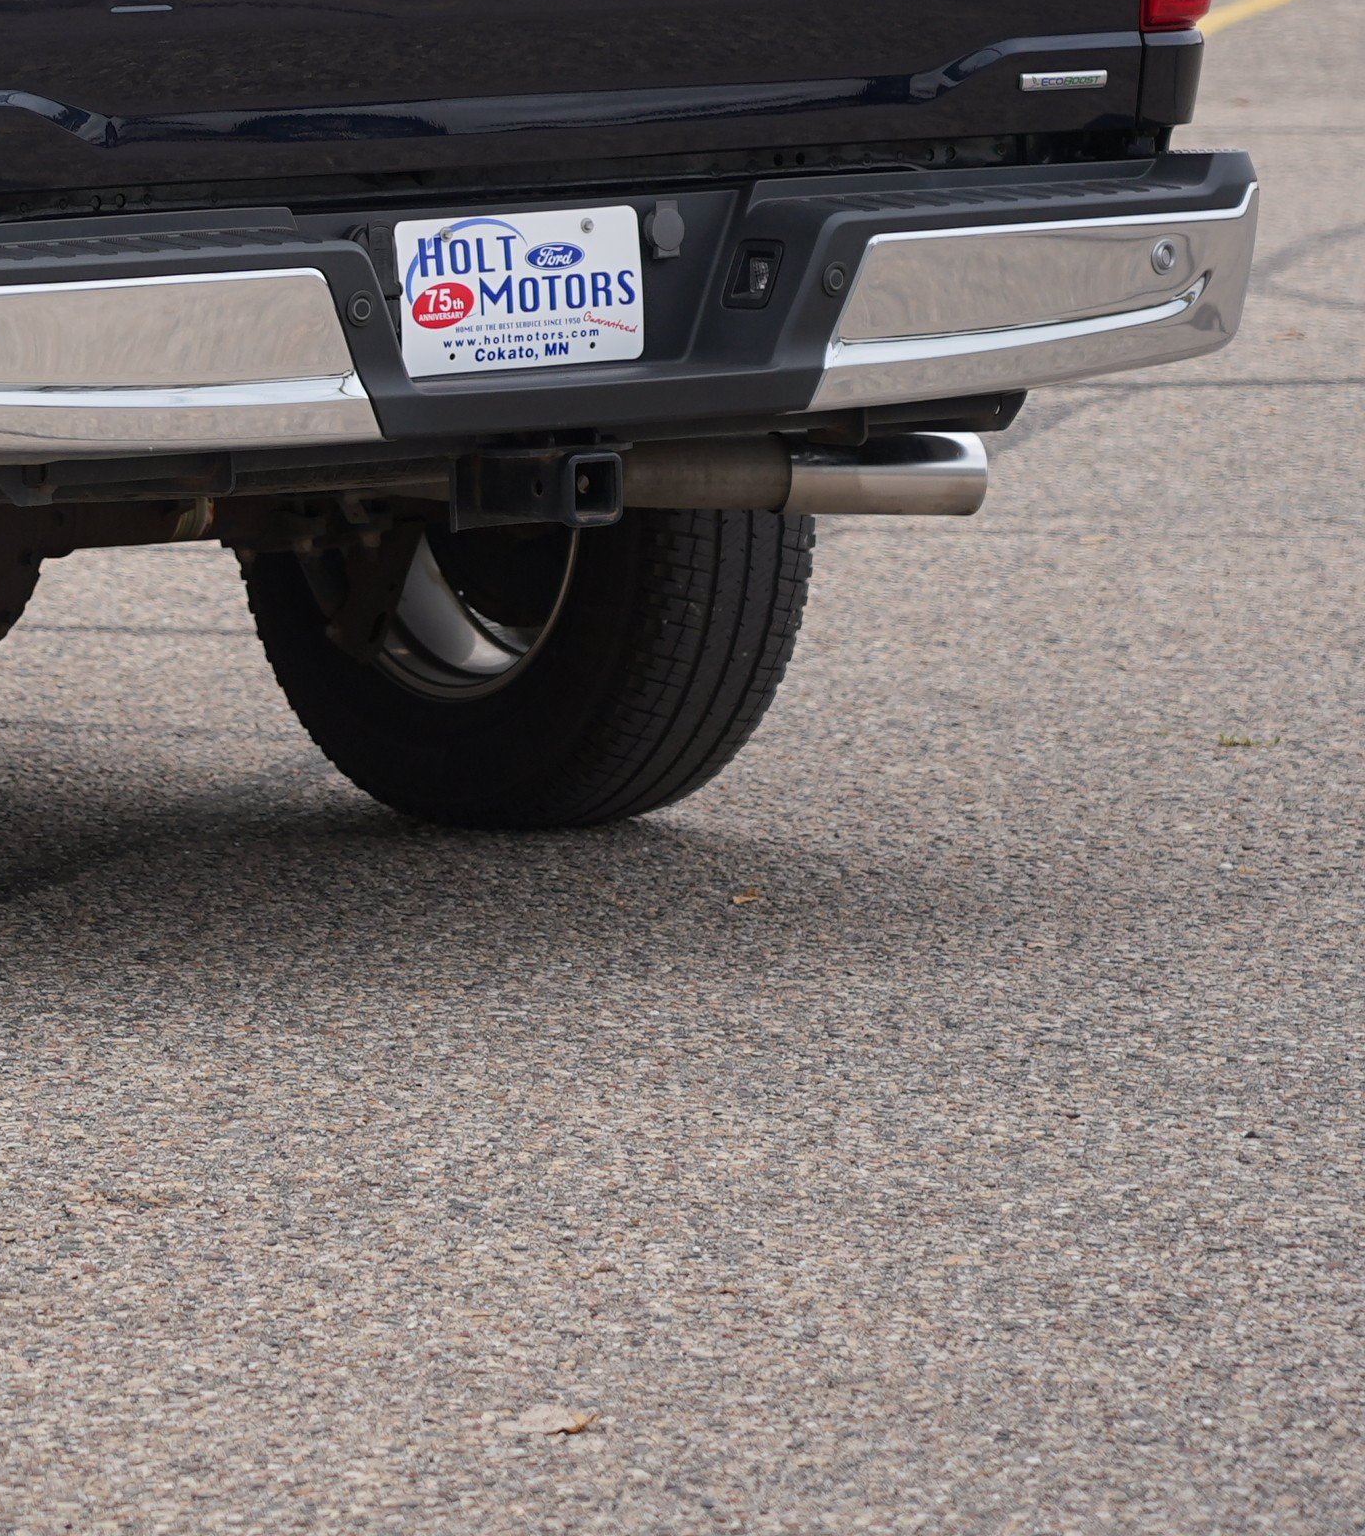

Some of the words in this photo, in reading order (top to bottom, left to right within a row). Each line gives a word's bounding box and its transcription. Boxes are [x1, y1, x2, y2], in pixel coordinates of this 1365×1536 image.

[418, 235, 517, 278] HOLT
[536, 248, 573, 267] Ford
[425, 288, 465, 313] 75th
[479, 270, 636, 316] MOTORS
[419, 311, 465, 322] ANNIVERSARY
[498, 322, 514, 330] BEST
[515, 320, 542, 329] SERVICE
[543, 319, 563, 327] SINCE
[565, 317, 581, 325] 1950
[583, 311, 638, 334] Guaranteed
[443, 328, 600, 348] www.holtmotors.com
[475, 347, 539, 362] Cokato,
[544, 342, 569, 356] MN
